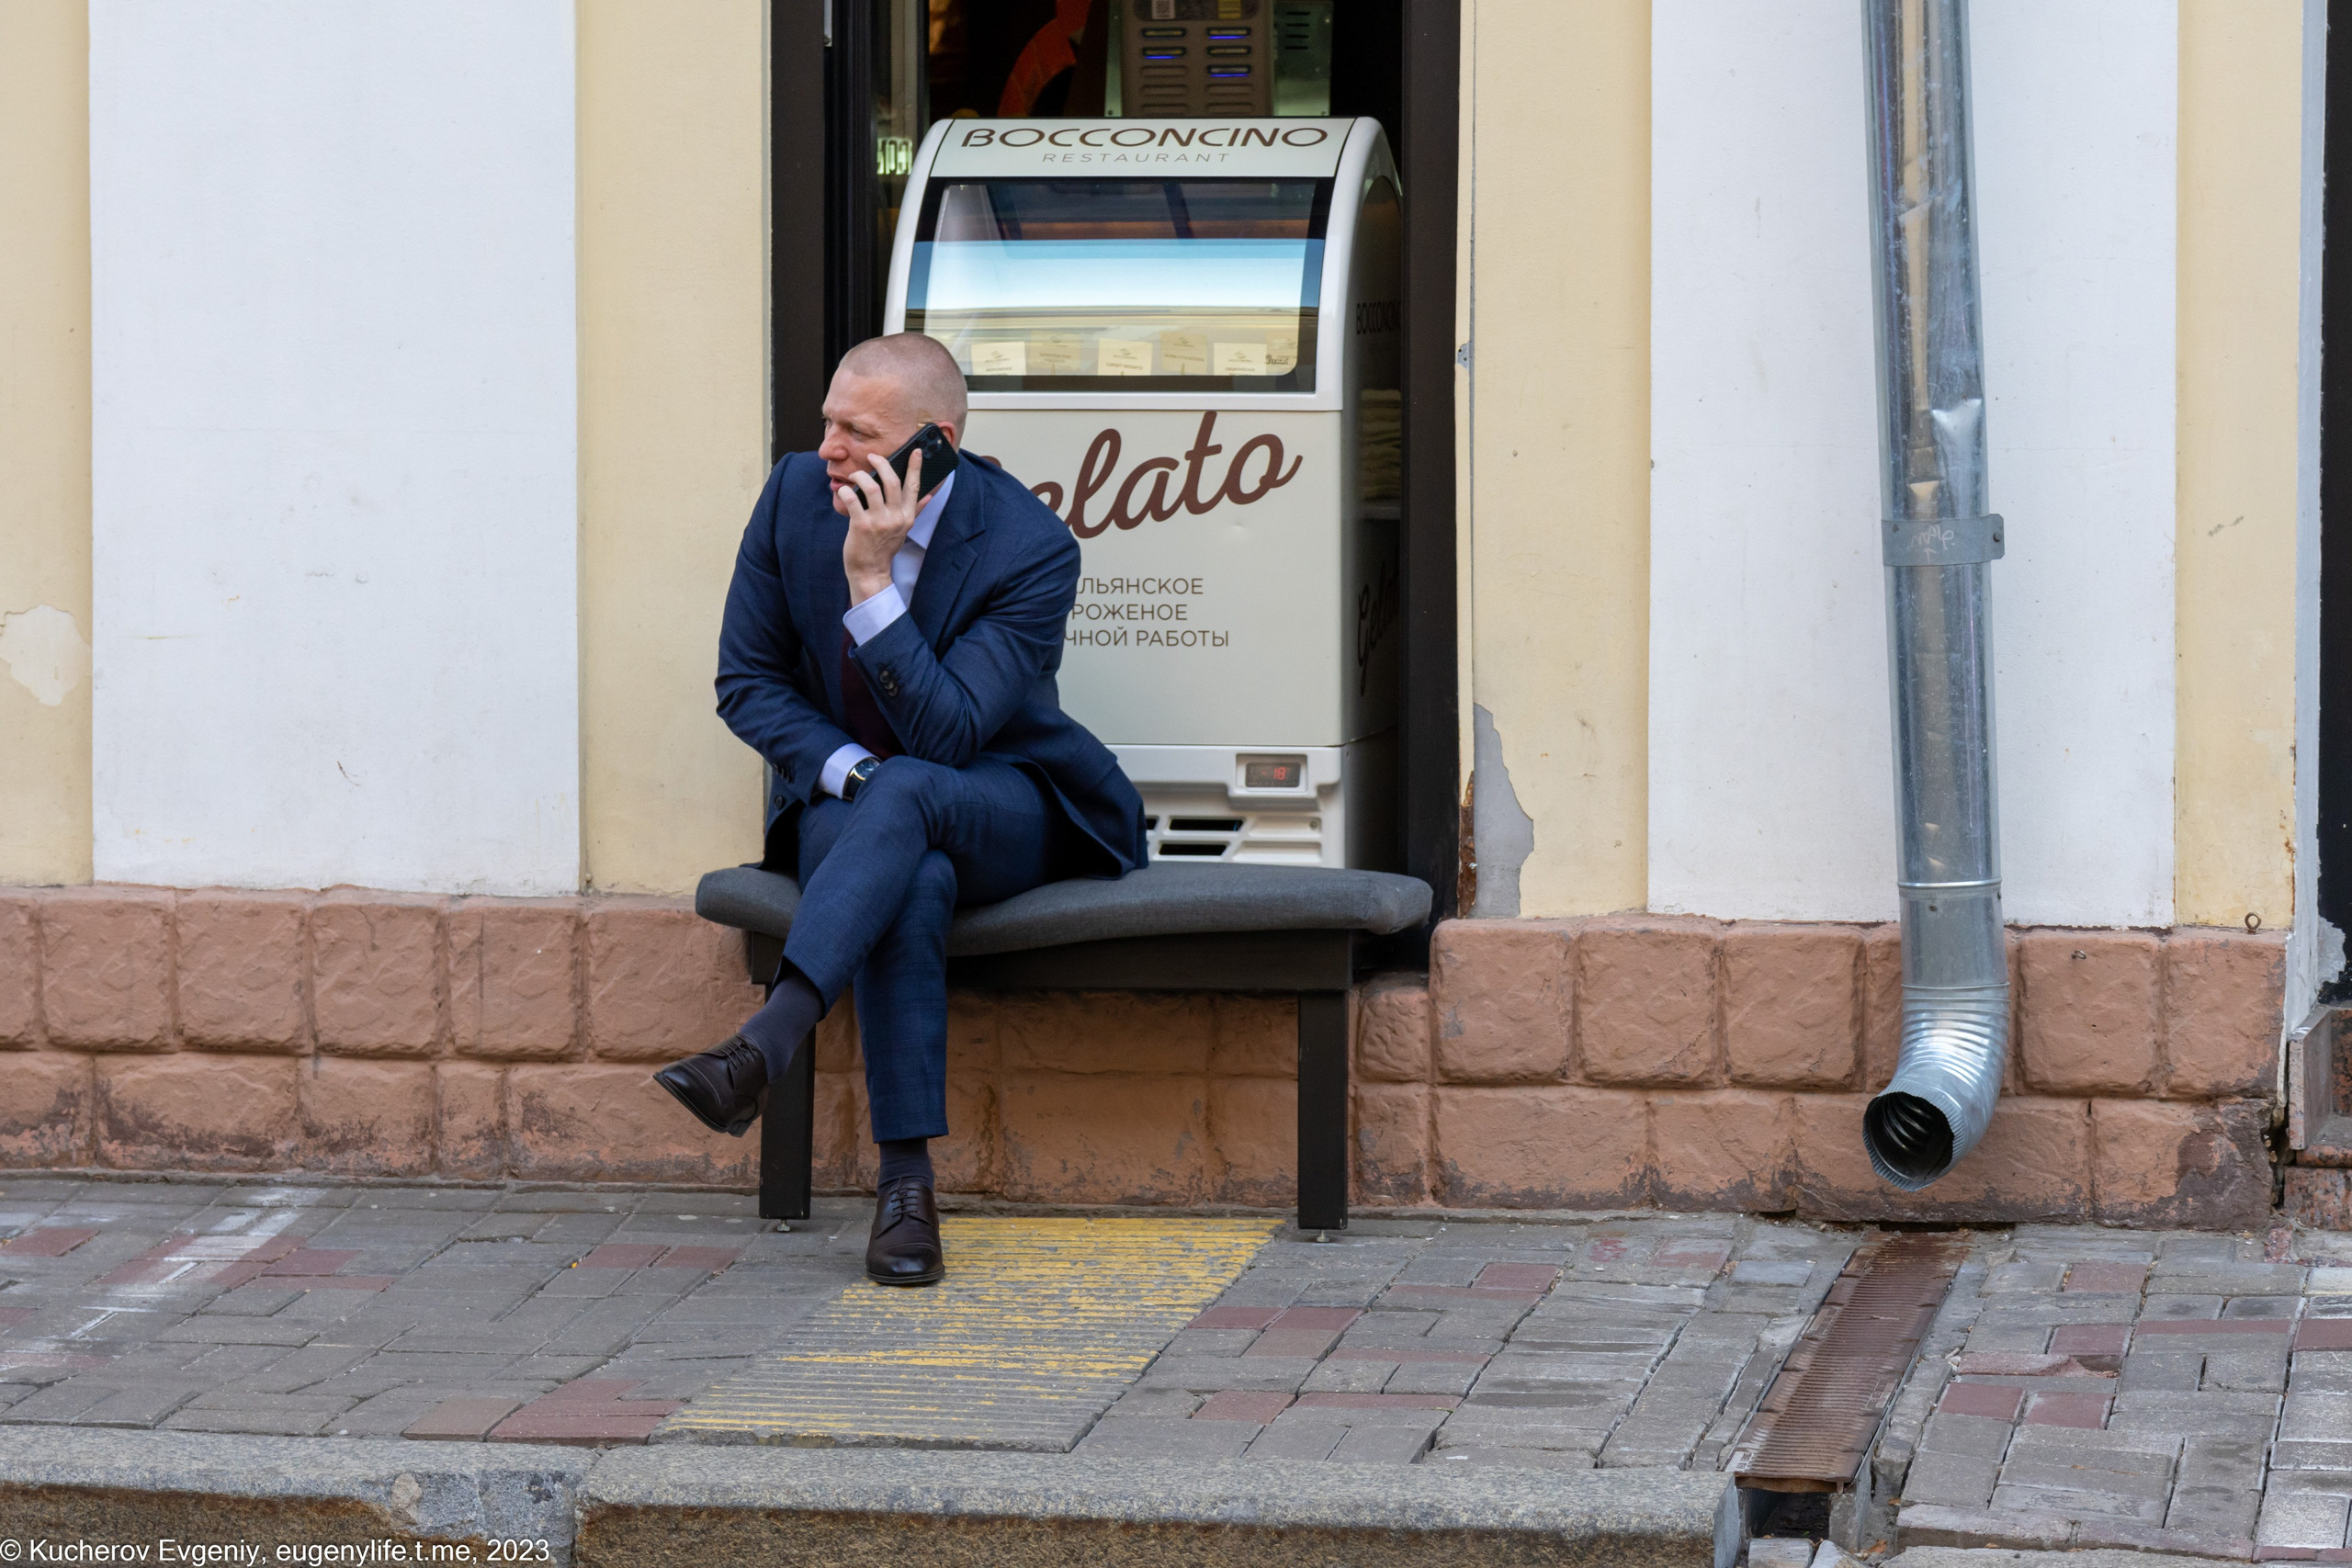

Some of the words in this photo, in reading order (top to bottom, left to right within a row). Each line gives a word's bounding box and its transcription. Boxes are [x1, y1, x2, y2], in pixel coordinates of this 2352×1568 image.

[961, 127, 1329, 148] BOCCONCINO
[1042, 152, 1230, 164] RESTAURANT
[980, 410, 1304, 539] lato
[1077, 577, 1204, 595] ЛЬЯНСКОЕ
[1071, 604, 1188, 621] РОЖЕНОЕ
[1065, 626, 1128, 647] ЧНОЙ
[1136, 630, 1229, 648] РАБОТЫ
